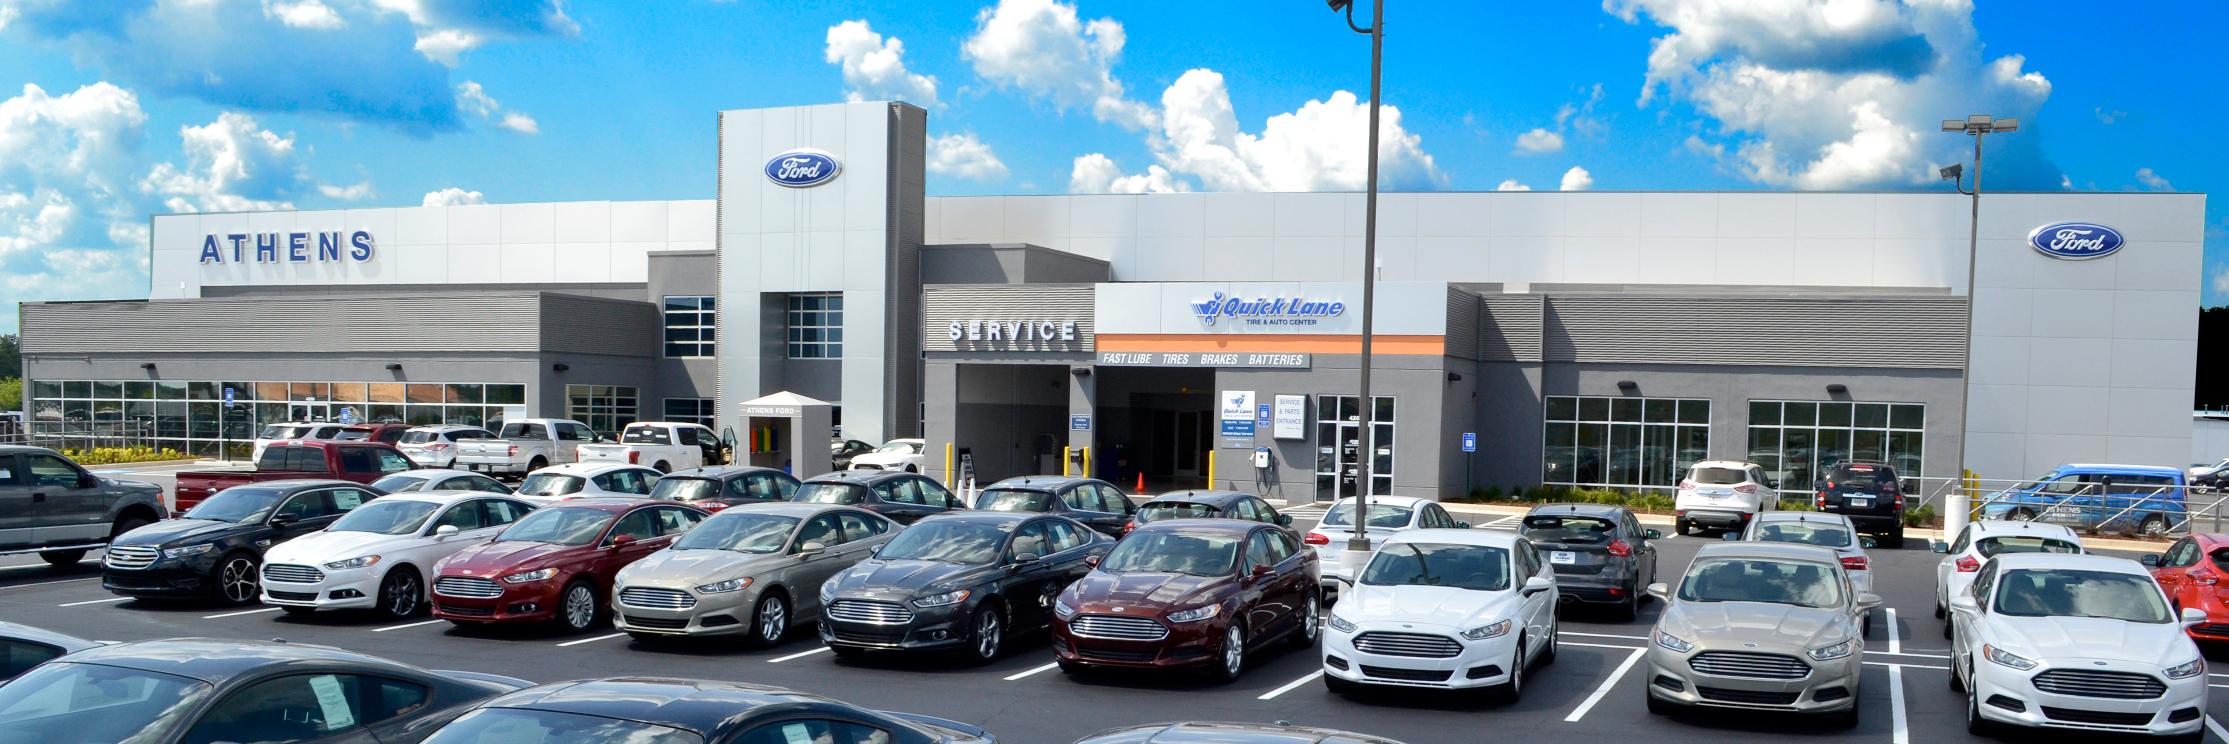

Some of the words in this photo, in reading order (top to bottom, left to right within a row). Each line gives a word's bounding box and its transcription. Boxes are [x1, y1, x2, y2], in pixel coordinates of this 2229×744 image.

[778, 157, 822, 180] Ford
[199, 230, 375, 264] ATHENS
[2050, 228, 2106, 251] Ford
[1222, 297, 1286, 318] Quick
[1286, 297, 1345, 317] Lane
[948, 320, 1076, 342] SERVICE
[1103, 353, 1127, 364] FAST
[1127, 353, 1152, 364] LUBE
[1162, 353, 1190, 365] TIRES
[1200, 353, 1239, 365] BRAKES
[1249, 354, 1304, 366] BATTERIES
[775, 407, 795, 415] FORD
